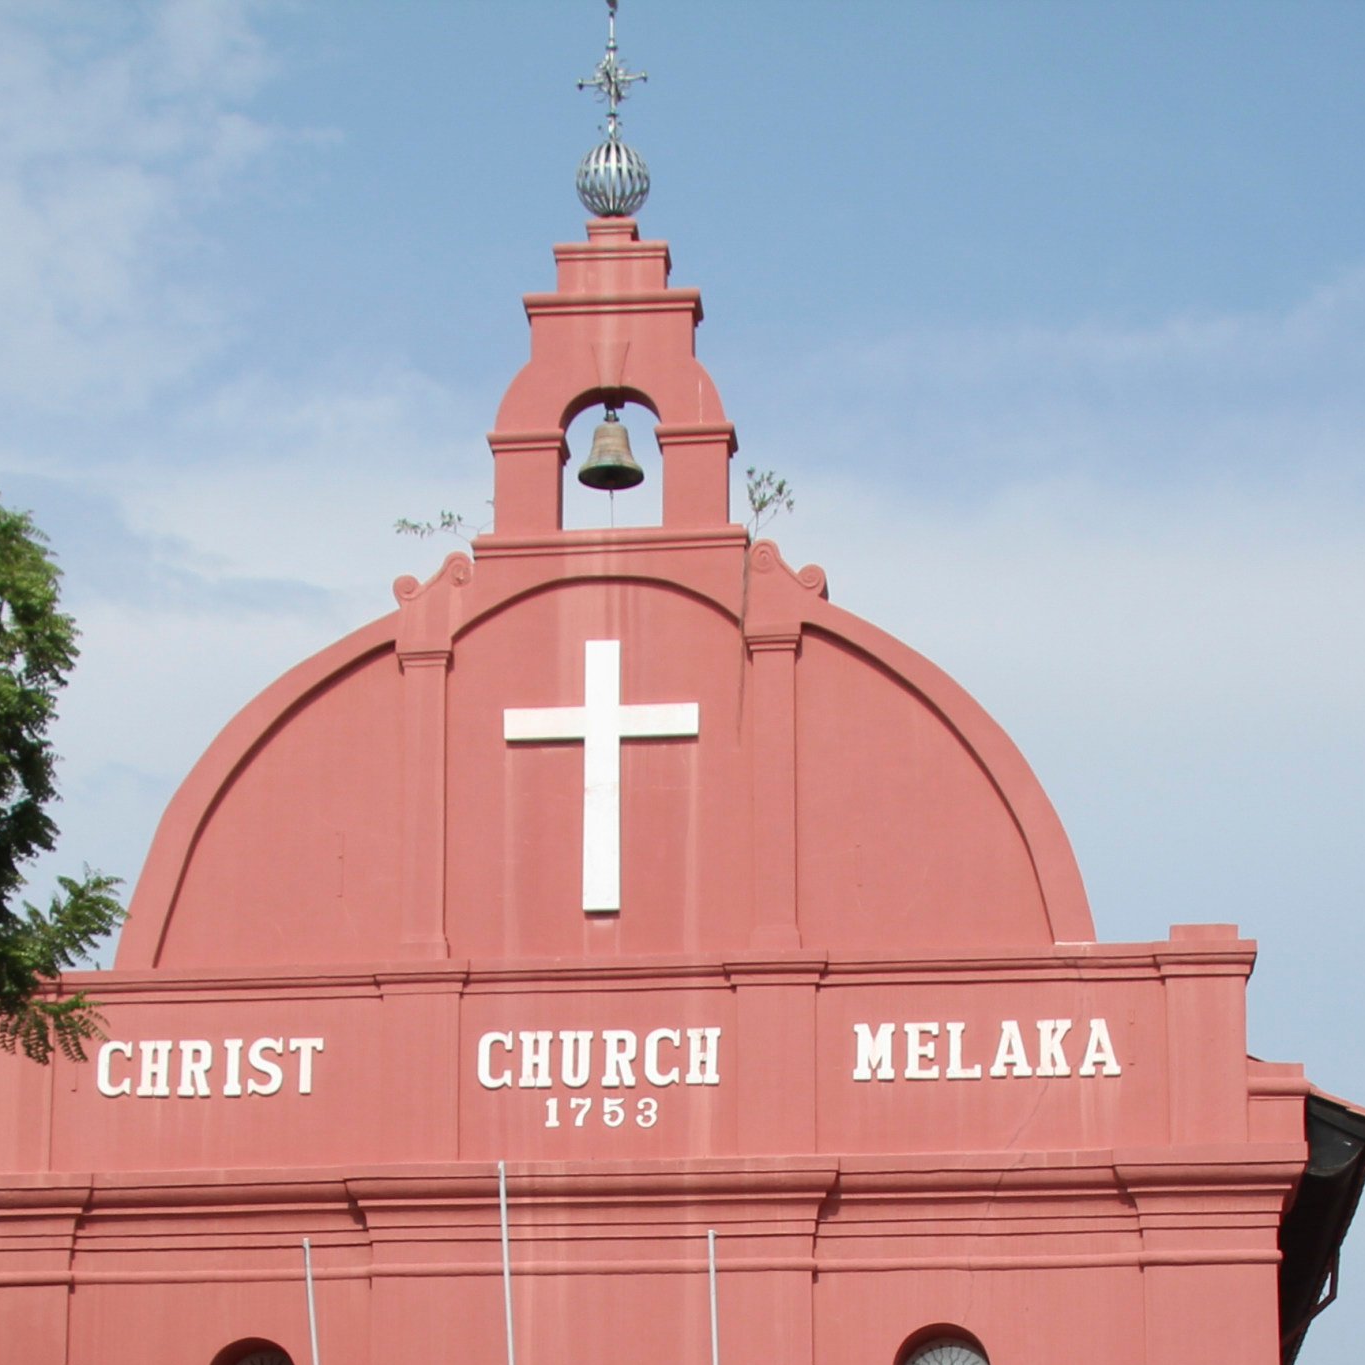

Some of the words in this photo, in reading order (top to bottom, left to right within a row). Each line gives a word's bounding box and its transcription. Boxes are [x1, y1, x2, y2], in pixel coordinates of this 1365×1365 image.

[96, 1036, 325, 1098] CHRIST
[477, 1026, 723, 1090] CHURCH
[852, 1017, 1123, 1082] MELAKA
[544, 1096, 660, 1129] 1753
